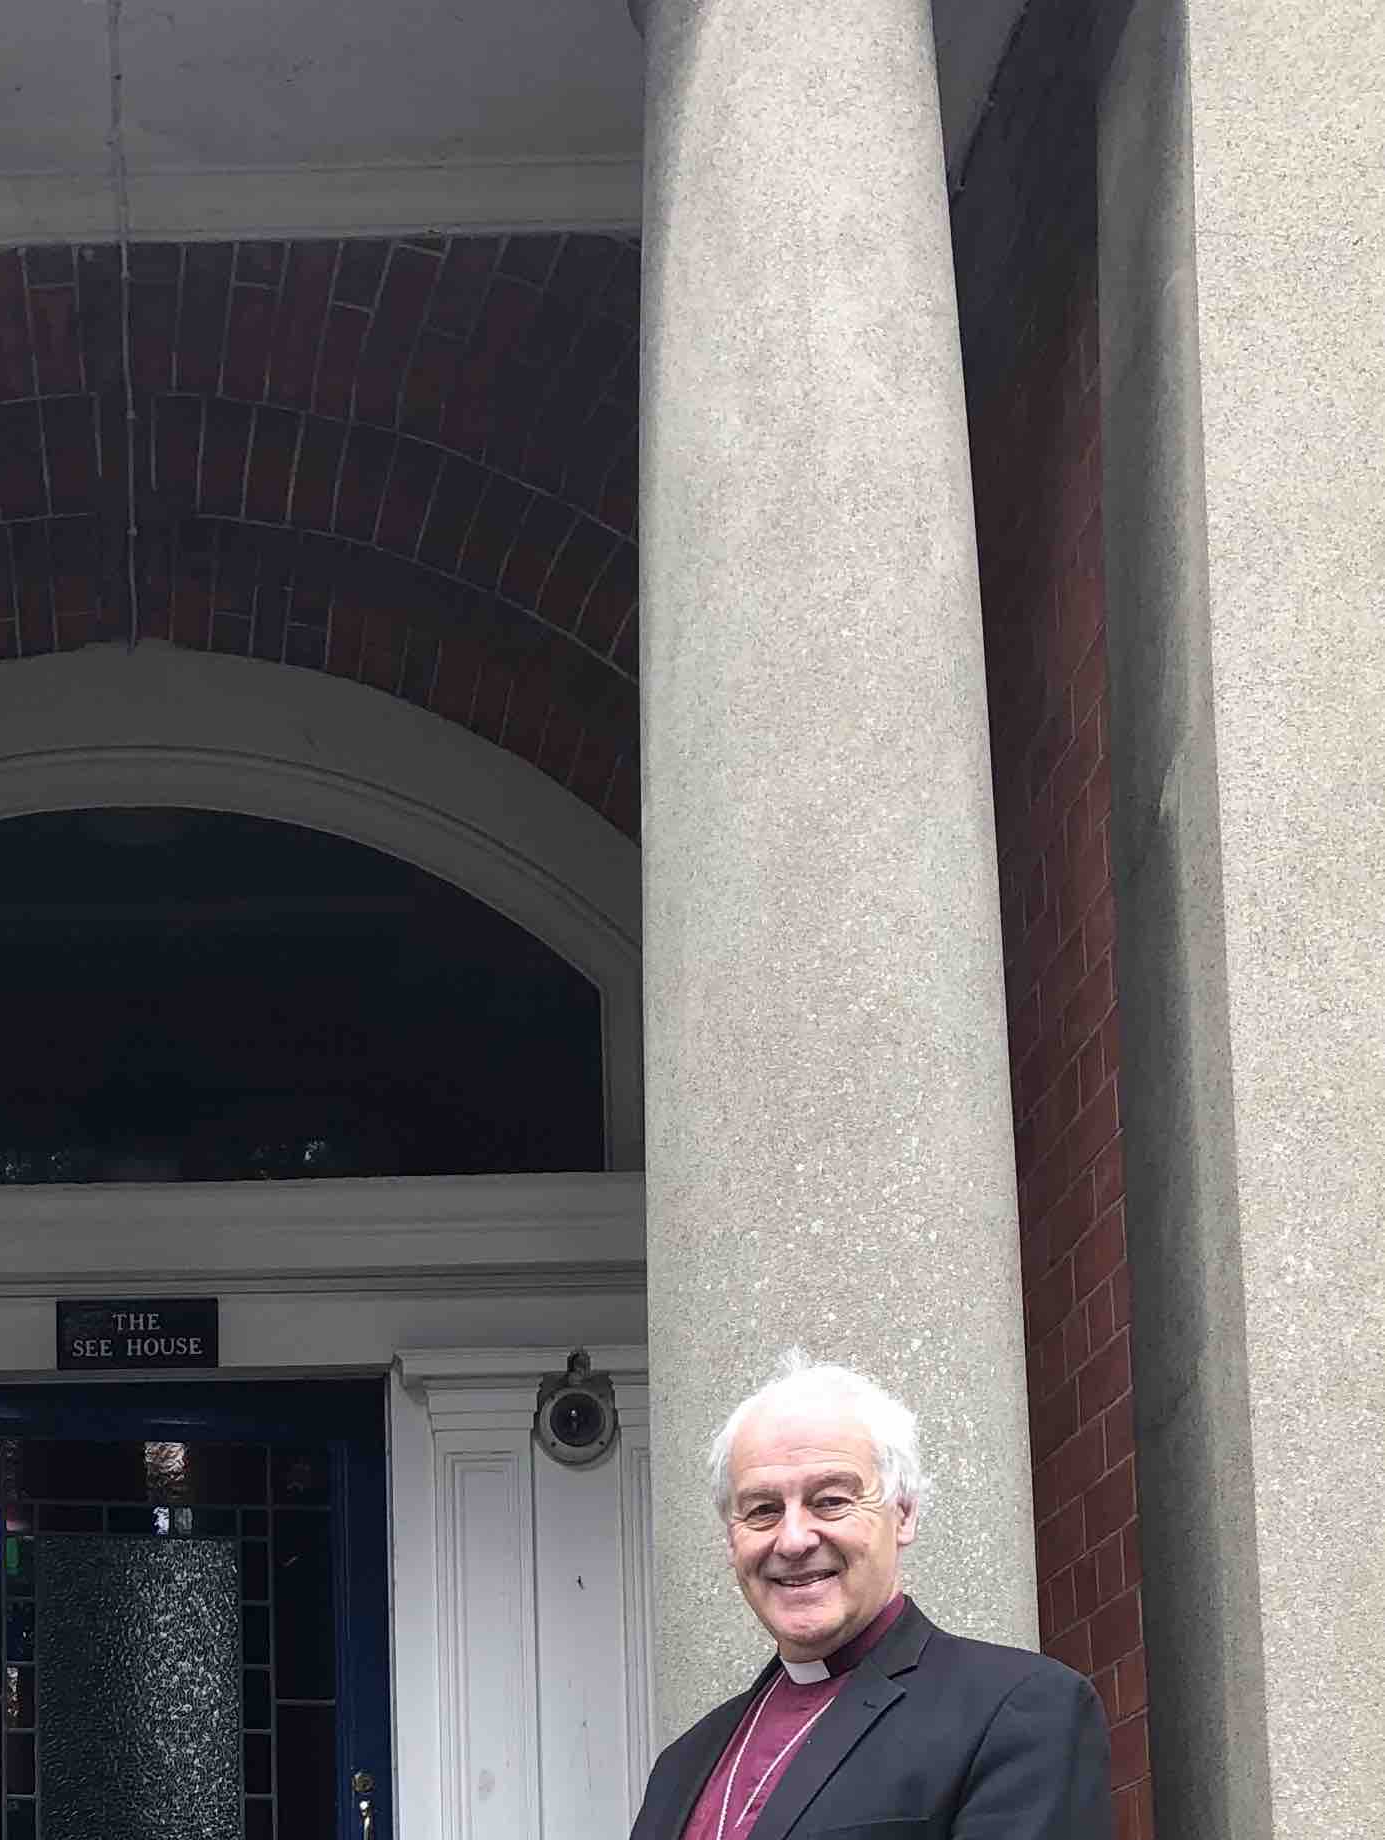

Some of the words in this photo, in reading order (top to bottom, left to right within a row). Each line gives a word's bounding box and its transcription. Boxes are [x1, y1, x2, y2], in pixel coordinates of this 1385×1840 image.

[111, 1313, 161, 1331] THE
[72, 1339, 113, 1357] SEE
[126, 1337, 203, 1356] HOUSE
